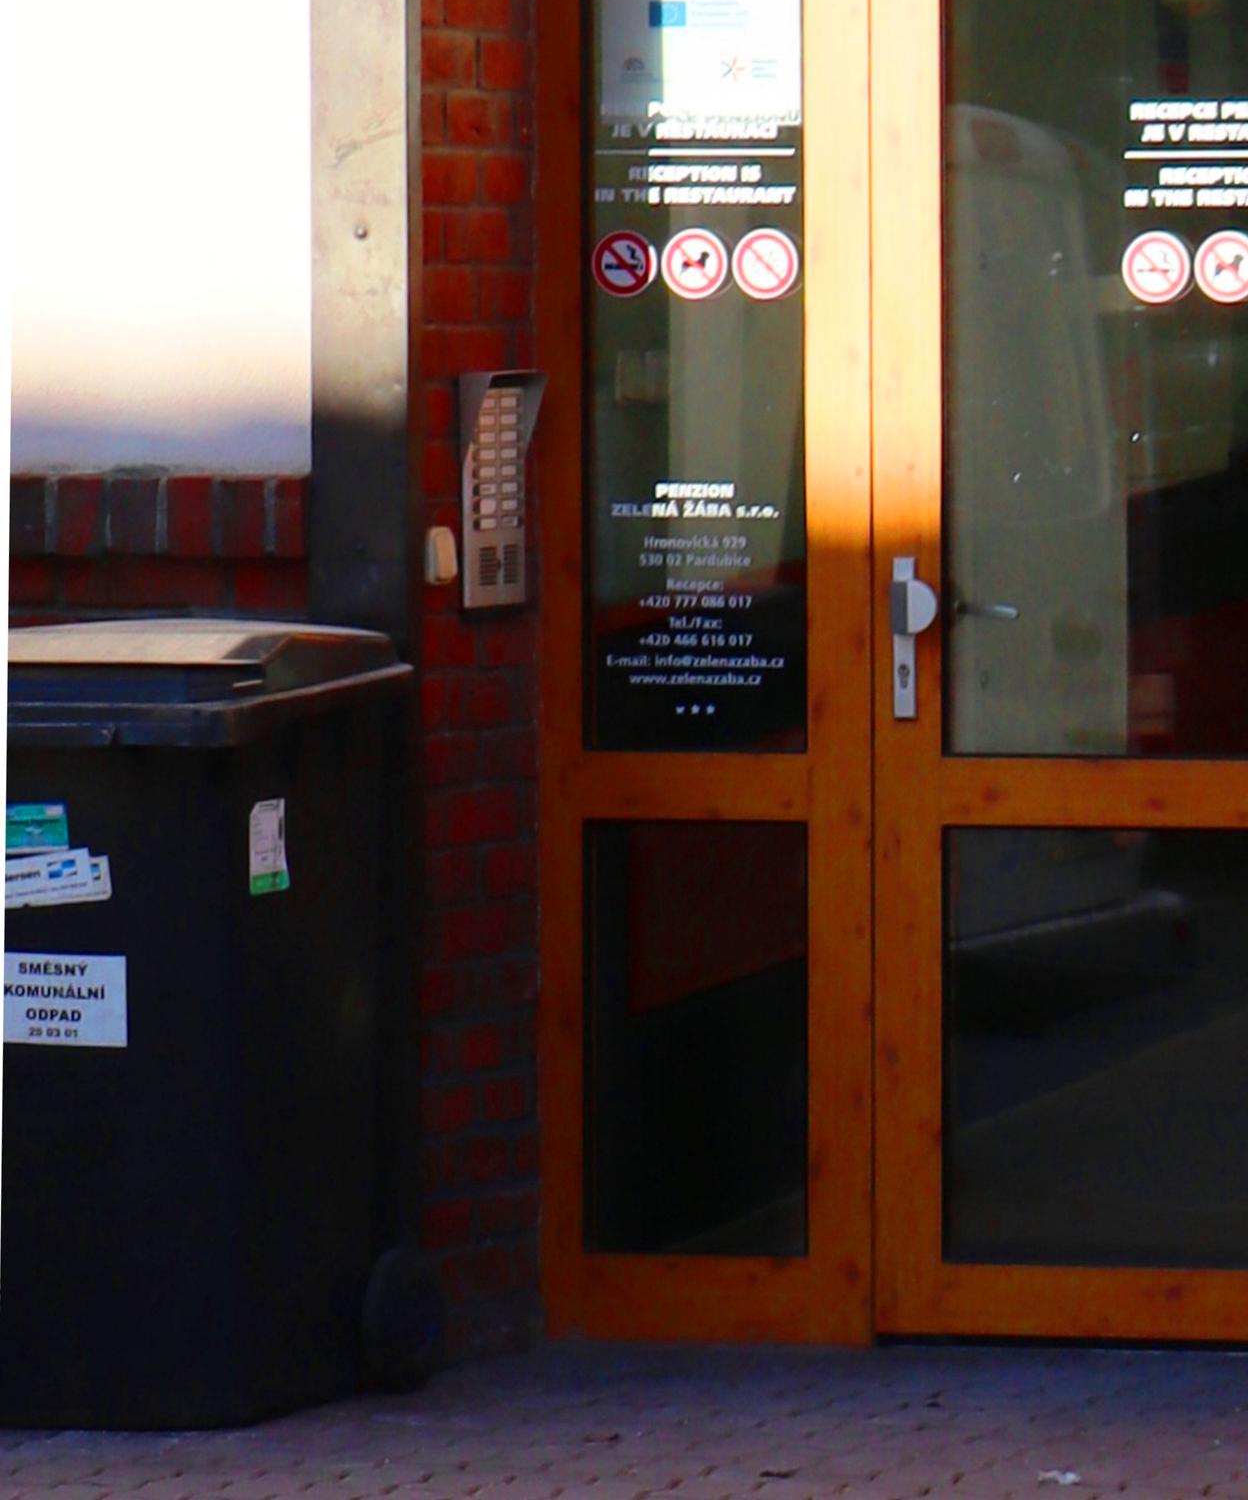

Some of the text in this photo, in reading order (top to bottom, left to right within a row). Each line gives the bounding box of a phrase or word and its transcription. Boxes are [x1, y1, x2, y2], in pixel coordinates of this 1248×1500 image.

[612, 124, 632, 138] JE
[637, 122, 654, 138] V
[1167, 123, 1185, 142] V
[740, 164, 762, 181] IS
[655, 483, 734, 498] PENZION
[611, 500, 679, 518] ZELENÁ
[683, 500, 732, 518] ŽÁBA
[639, 596, 670, 607] +420
[675, 596, 697, 607] 777
[639, 634, 670, 646] +420
[607, 654, 650, 667] E-mail:
[630, 673, 762, 685] www.zelenazaba.cz
[26, 1008, 82, 1022] ODPAD
